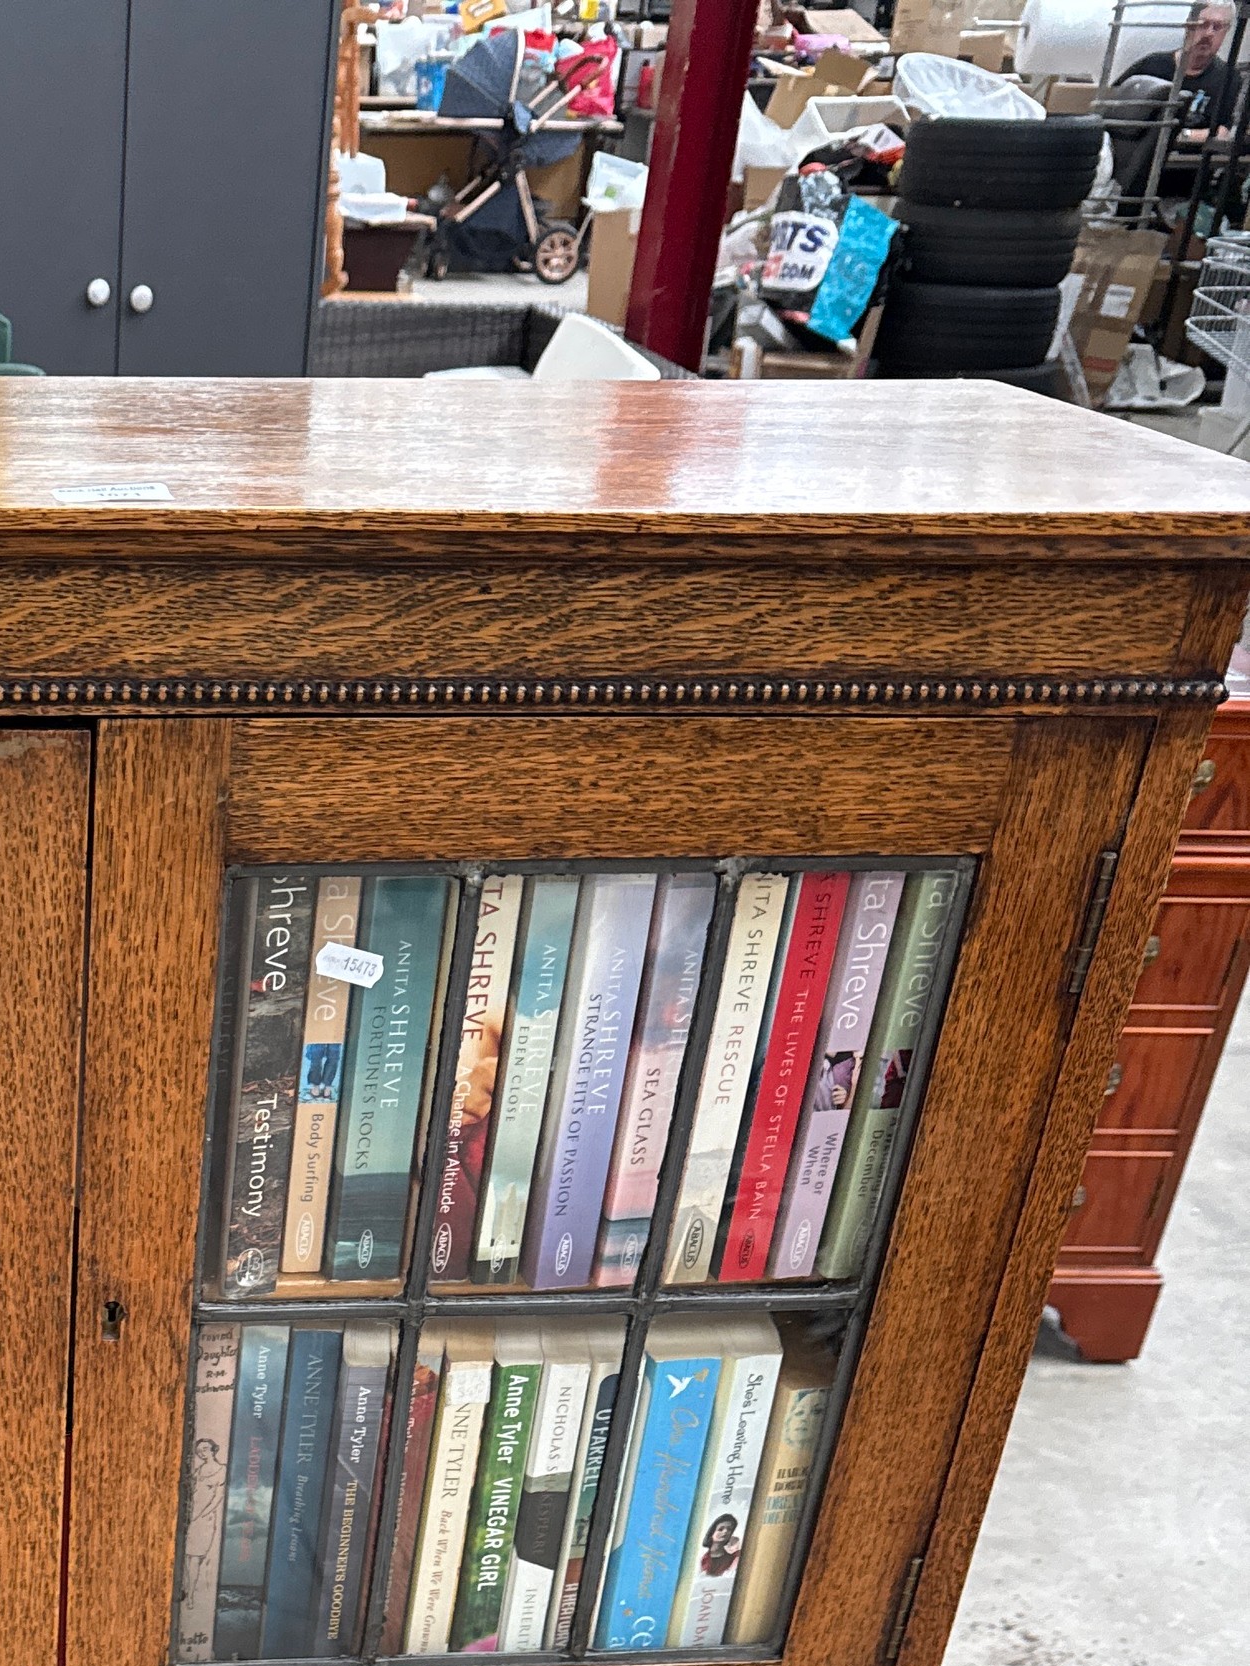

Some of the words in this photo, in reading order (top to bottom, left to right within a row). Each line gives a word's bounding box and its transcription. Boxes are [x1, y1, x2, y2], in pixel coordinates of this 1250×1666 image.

[800, 893, 831, 980] SHREVE
[342, 956, 378, 978] 15473
[392, 939, 412, 999] ANITA
[463, 929, 497, 1041] SHREVE
[534, 943, 558, 1003] ANITA
[602, 946, 627, 1005] ANITA
[676, 949, 699, 1008] ANITA
[734, 927, 764, 1013] SHREVE
[837, 922, 888, 1030] Shreve
[900, 922, 948, 1028] Shreve
[790, 988, 810, 1024] THE
[379, 1004, 411, 1111] SHREVE
[516, 1025, 530, 1068] EDEN
[577, 993, 603, 1074] STRANGE
[780, 1030, 803, 1078] LIVES
[518, 1008, 554, 1115] SHREVE
[586, 1010, 621, 1116] SHREVE
[644, 1067, 661, 1101] SEA
[715, 1025, 744, 1106] RESCUE
[449, 1081, 472, 1137] Change
[505, 1075, 523, 1124] CLOSE
[571, 1080, 589, 1116] FITS
[773, 1082, 791, 1110] OF
[241, 1092, 281, 1219] Testimony
[312, 1112, 325, 1152] Body
[353, 1110, 374, 1171] ROCKS
[448, 1139, 463, 1154] in
[567, 1120, 582, 1142] OF
[630, 1107, 654, 1166] GLASS
[760, 1114, 784, 1173] STELLA
[820, 1132, 839, 1177] Where
[300, 1152, 321, 1204] Surfing
[439, 1157, 462, 1214] Altitude
[554, 1150, 577, 1218] PASSION
[800, 1145, 821, 1186] When
[813, 1181, 825, 1196] or
[858, 1130, 885, 1198] December
[749, 1180, 768, 1220] BAIN
[434, 1229, 450, 1269] ABACUS
[686, 1226, 703, 1268] ABACUS
[257, 1345, 272, 1381] Anne
[303, 1354, 323, 1407] ANNE
[251, 1384, 268, 1420] Tyler
[355, 1386, 372, 1423] Anne
[504, 1374, 530, 1420] Anne
[742, 1373, 764, 1408] She's
[297, 1411, 318, 1464] TYLER
[350, 1426, 367, 1464] Tyler
[498, 1420, 522, 1464] Tyler
[550, 1386, 572, 1465] NICHOLAS
[726, 1410, 756, 1463] Leaving
[344, 1479, 358, 1506] THE
[442, 1444, 466, 1499] TYLER
[721, 1464, 743, 1505] Home
[439, 1510, 453, 1535] Back
[484, 1477, 513, 1549] VINEGAR
[335, 1509, 354, 1582] BEGINNER'S
[433, 1539, 449, 1567] When
[430, 1570, 443, 1586] We
[477, 1554, 501, 1592] GIRL
[327, 1584, 344, 1640] GOODBYE
[425, 1588, 441, 1612] Were
[697, 1587, 716, 1622] JOAN
